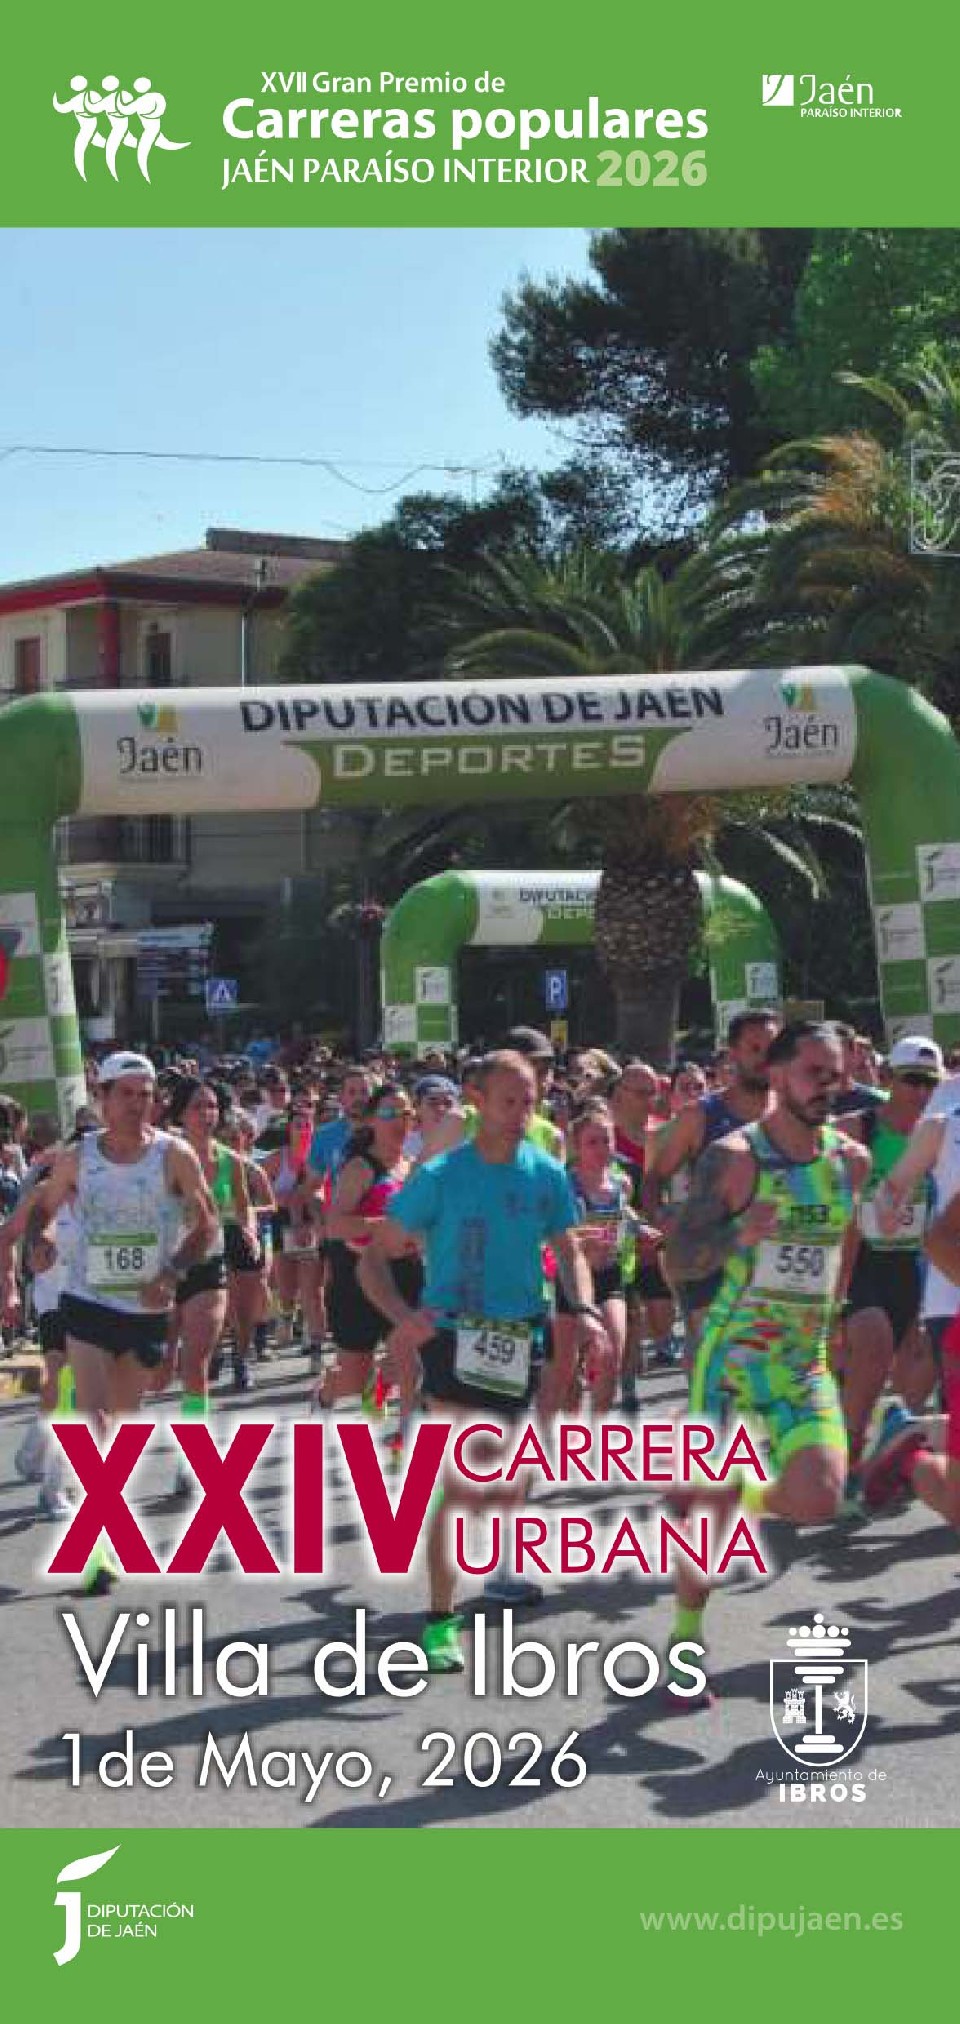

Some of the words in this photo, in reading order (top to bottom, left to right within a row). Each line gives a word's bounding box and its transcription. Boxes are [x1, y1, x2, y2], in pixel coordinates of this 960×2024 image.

[239, 689, 530, 732] DIPUTACIÓN
[543, 692, 603, 723] DE
[615, 681, 725, 720] JAÉN
[764, 713, 838, 750] Jaén
[118, 736, 203, 774] Jaén
[550, 976, 563, 1001] P
[103, 1246, 143, 1271] 168
[776, 1245, 825, 1277] 550
[474, 1330, 516, 1364] 459
